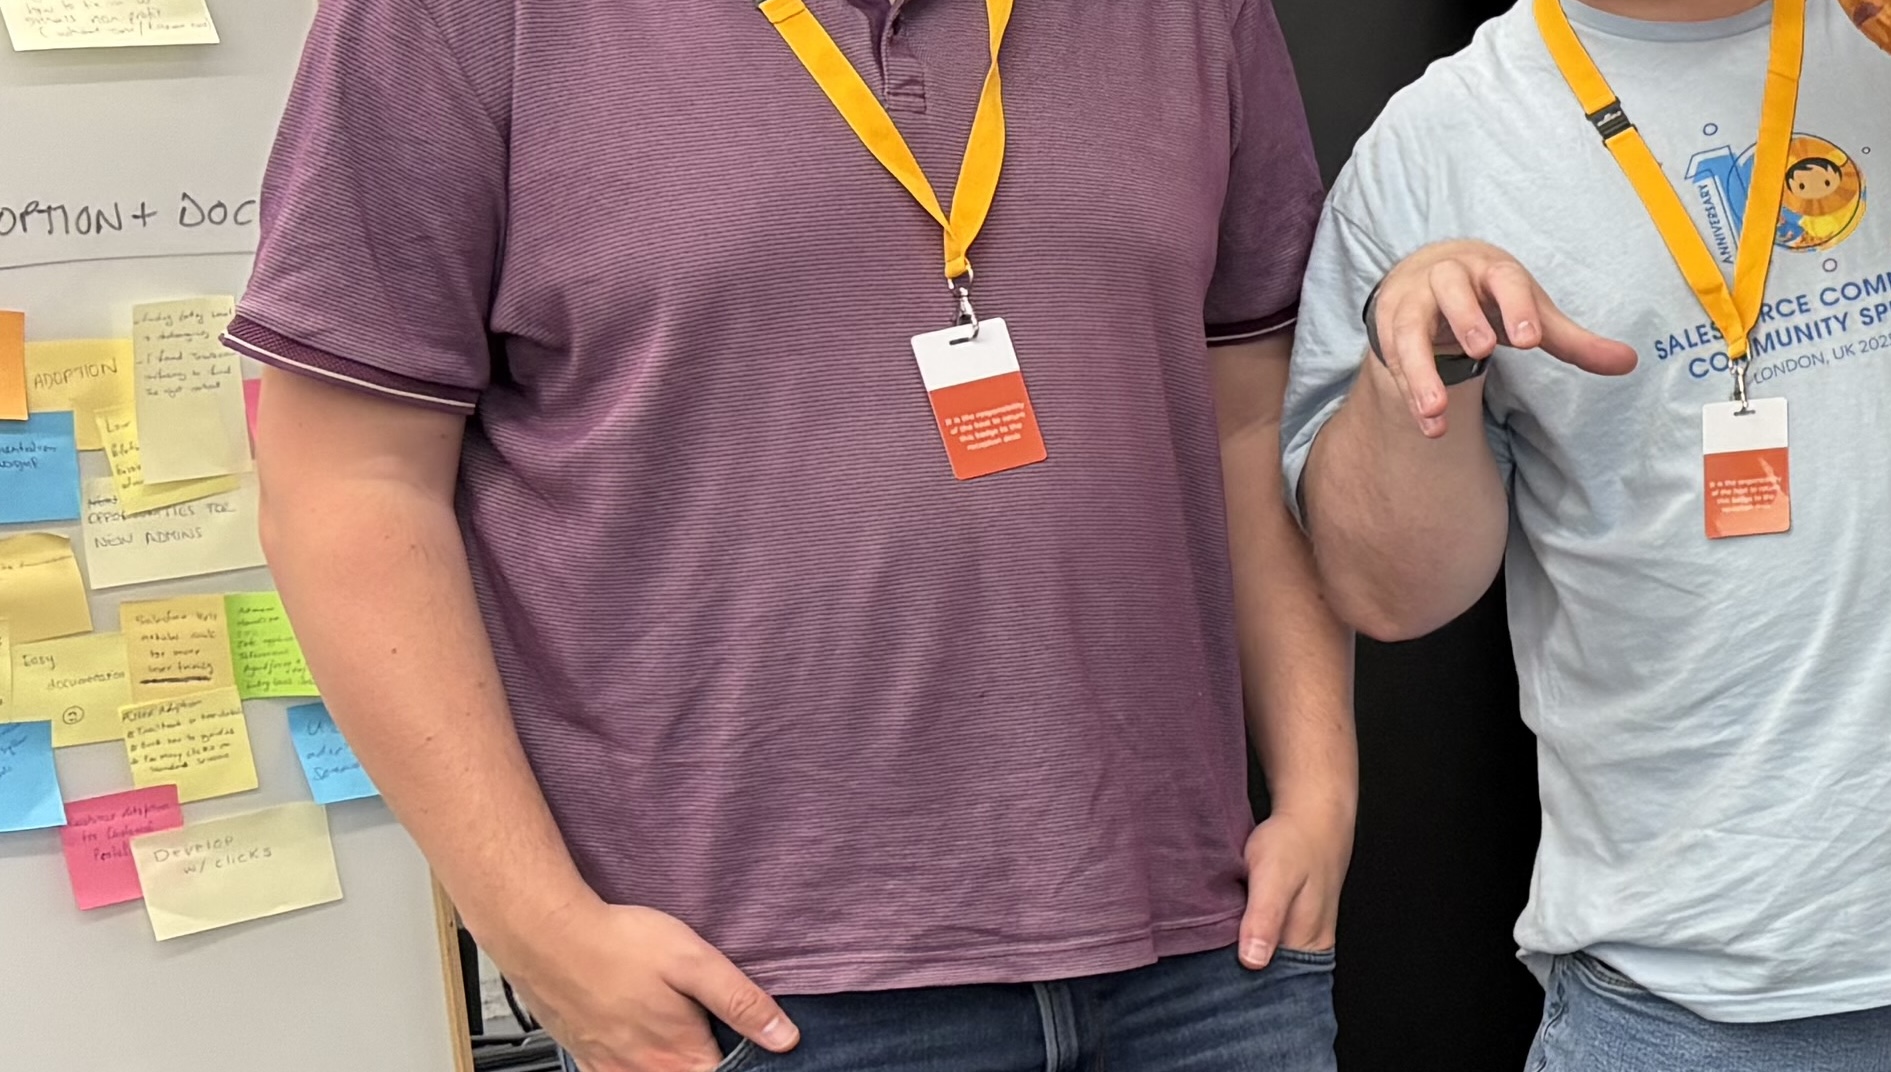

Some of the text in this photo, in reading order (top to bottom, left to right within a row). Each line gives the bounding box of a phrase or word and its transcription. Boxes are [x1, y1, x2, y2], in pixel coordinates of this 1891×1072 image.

[1697, 183, 1735, 265] ANNIVERSARY
[1653, 294, 1812, 361] SALESRCE
[1688, 311, 1850, 378] COMUNITY
[34, 356, 118, 390] ADOPTION
[1753, 352, 1831, 385] LONDON,
[1832, 342, 1856, 361] UK
[145, 528, 204, 545] ADMINS
[153, 835, 235, 863] Develop
[215, 846, 273, 869] clicks
